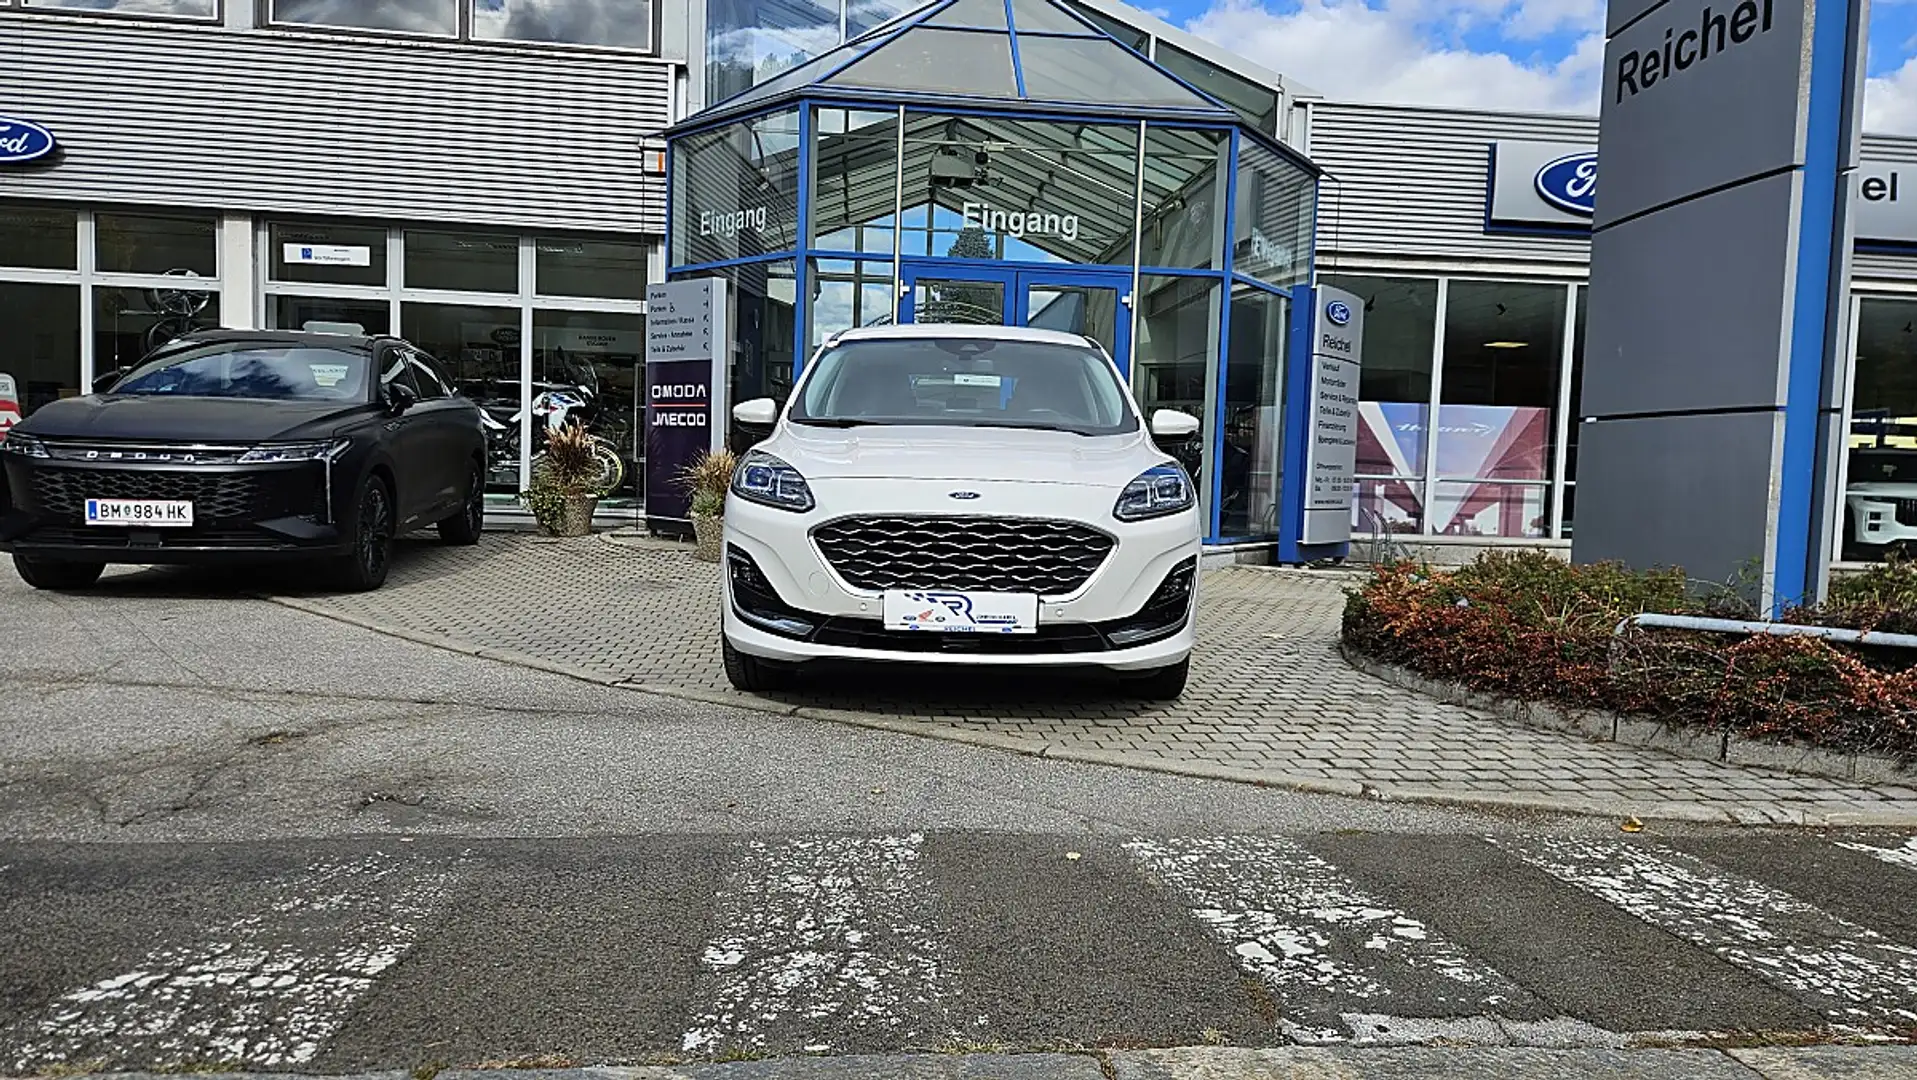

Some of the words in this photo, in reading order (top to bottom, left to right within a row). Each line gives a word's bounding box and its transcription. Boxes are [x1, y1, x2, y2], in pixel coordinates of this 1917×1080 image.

[1616, 0, 1774, 105] Reichel
[0, 125, 30, 153] rd
[700, 206, 767, 237] Eingang
[963, 201, 1079, 241] Eingang
[1322, 333, 1352, 353] Reichel
[652, 384, 706, 398] OMODA
[652, 413, 706, 426] JAECOO
[100, 504, 121, 518] BM
[134, 505, 163, 519] 984
[167, 504, 187, 519] HK
